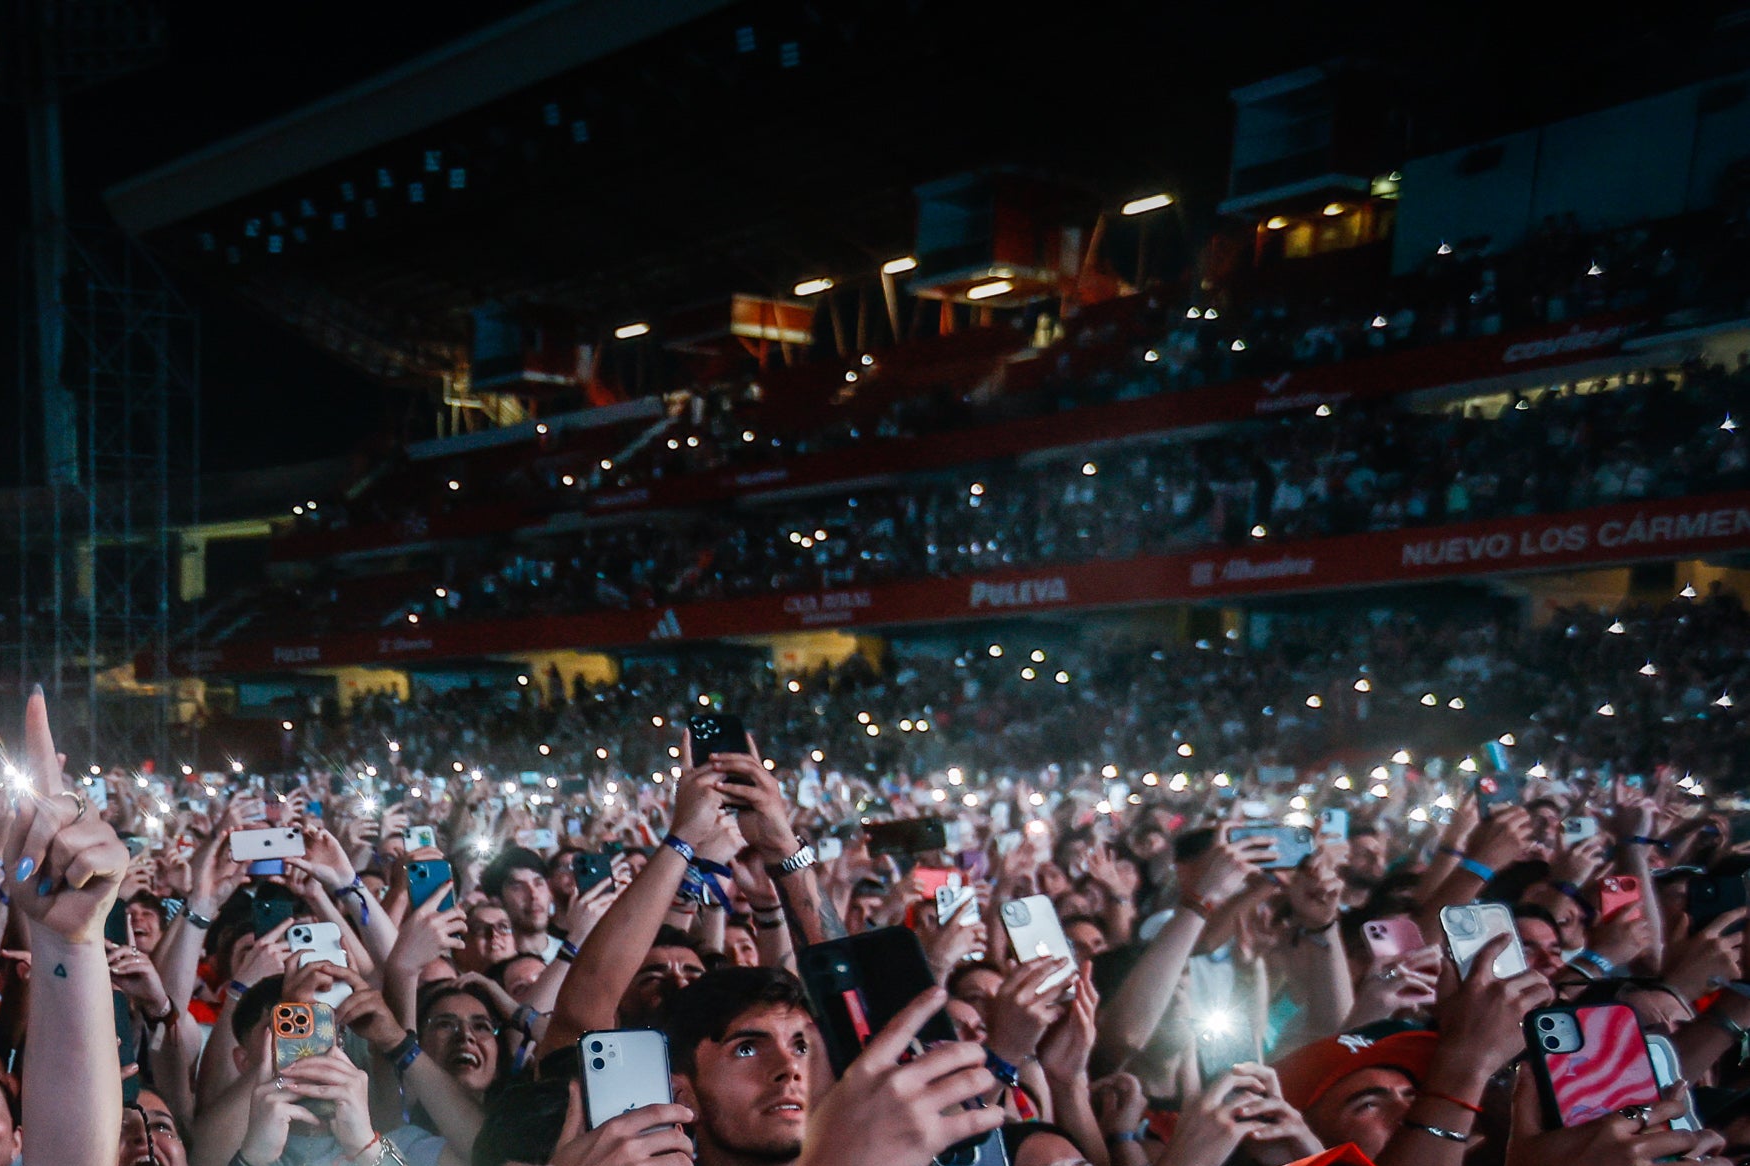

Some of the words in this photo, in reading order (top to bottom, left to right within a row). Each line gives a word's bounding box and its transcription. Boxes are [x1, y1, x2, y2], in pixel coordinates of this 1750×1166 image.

[1401, 531, 1512, 567] NUEVO
[1517, 525, 1590, 556] LOS
[969, 577, 1068, 608] PULEVA
